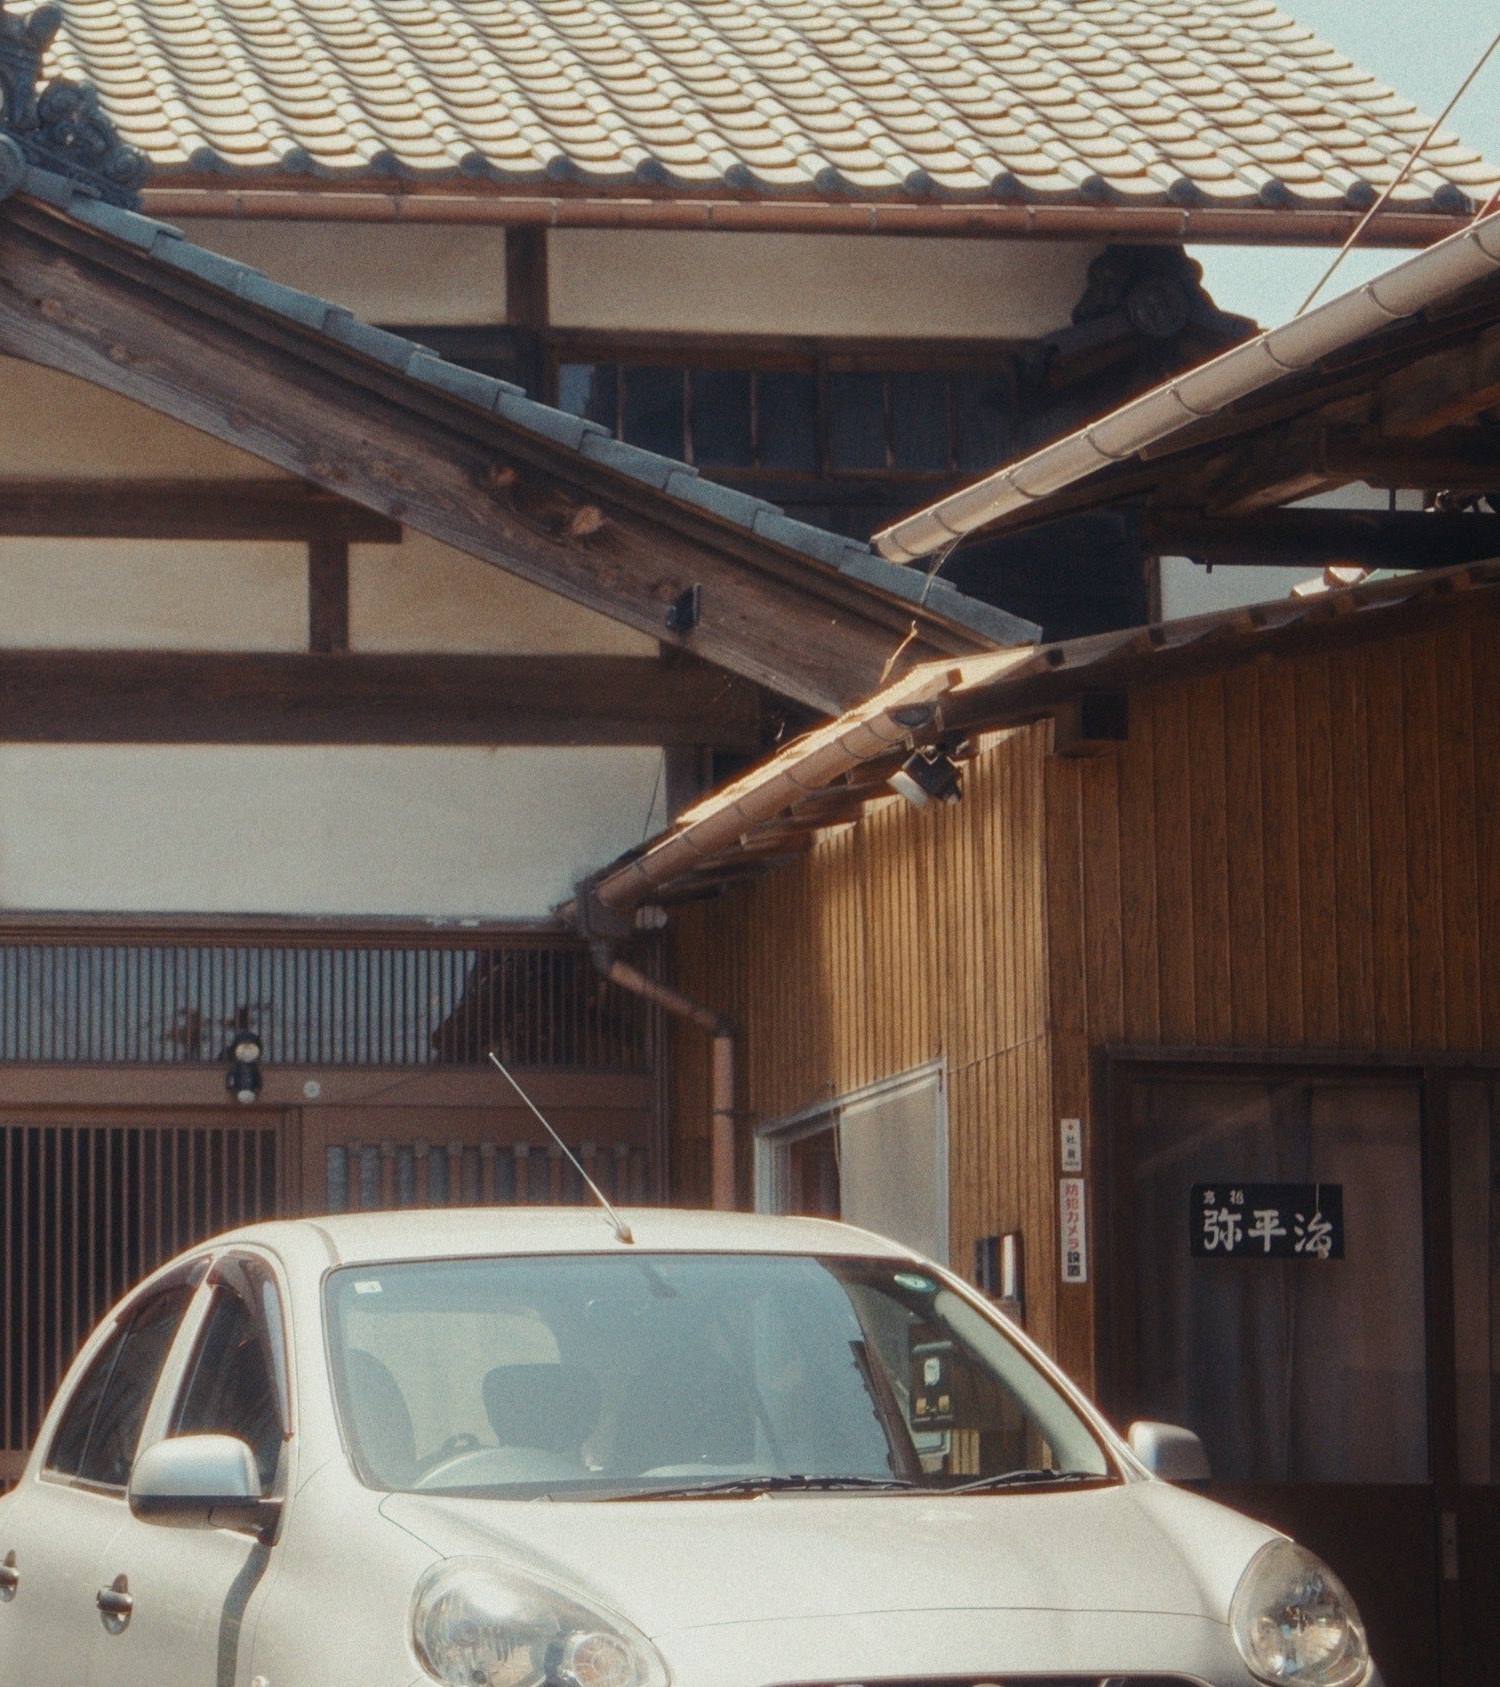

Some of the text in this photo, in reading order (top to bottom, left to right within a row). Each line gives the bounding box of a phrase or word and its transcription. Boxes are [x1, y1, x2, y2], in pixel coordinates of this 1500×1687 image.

[1065, 1183, 1081, 1277] 防犯カメラ設置
[1204, 1207, 1333, 1256] 弥平治
